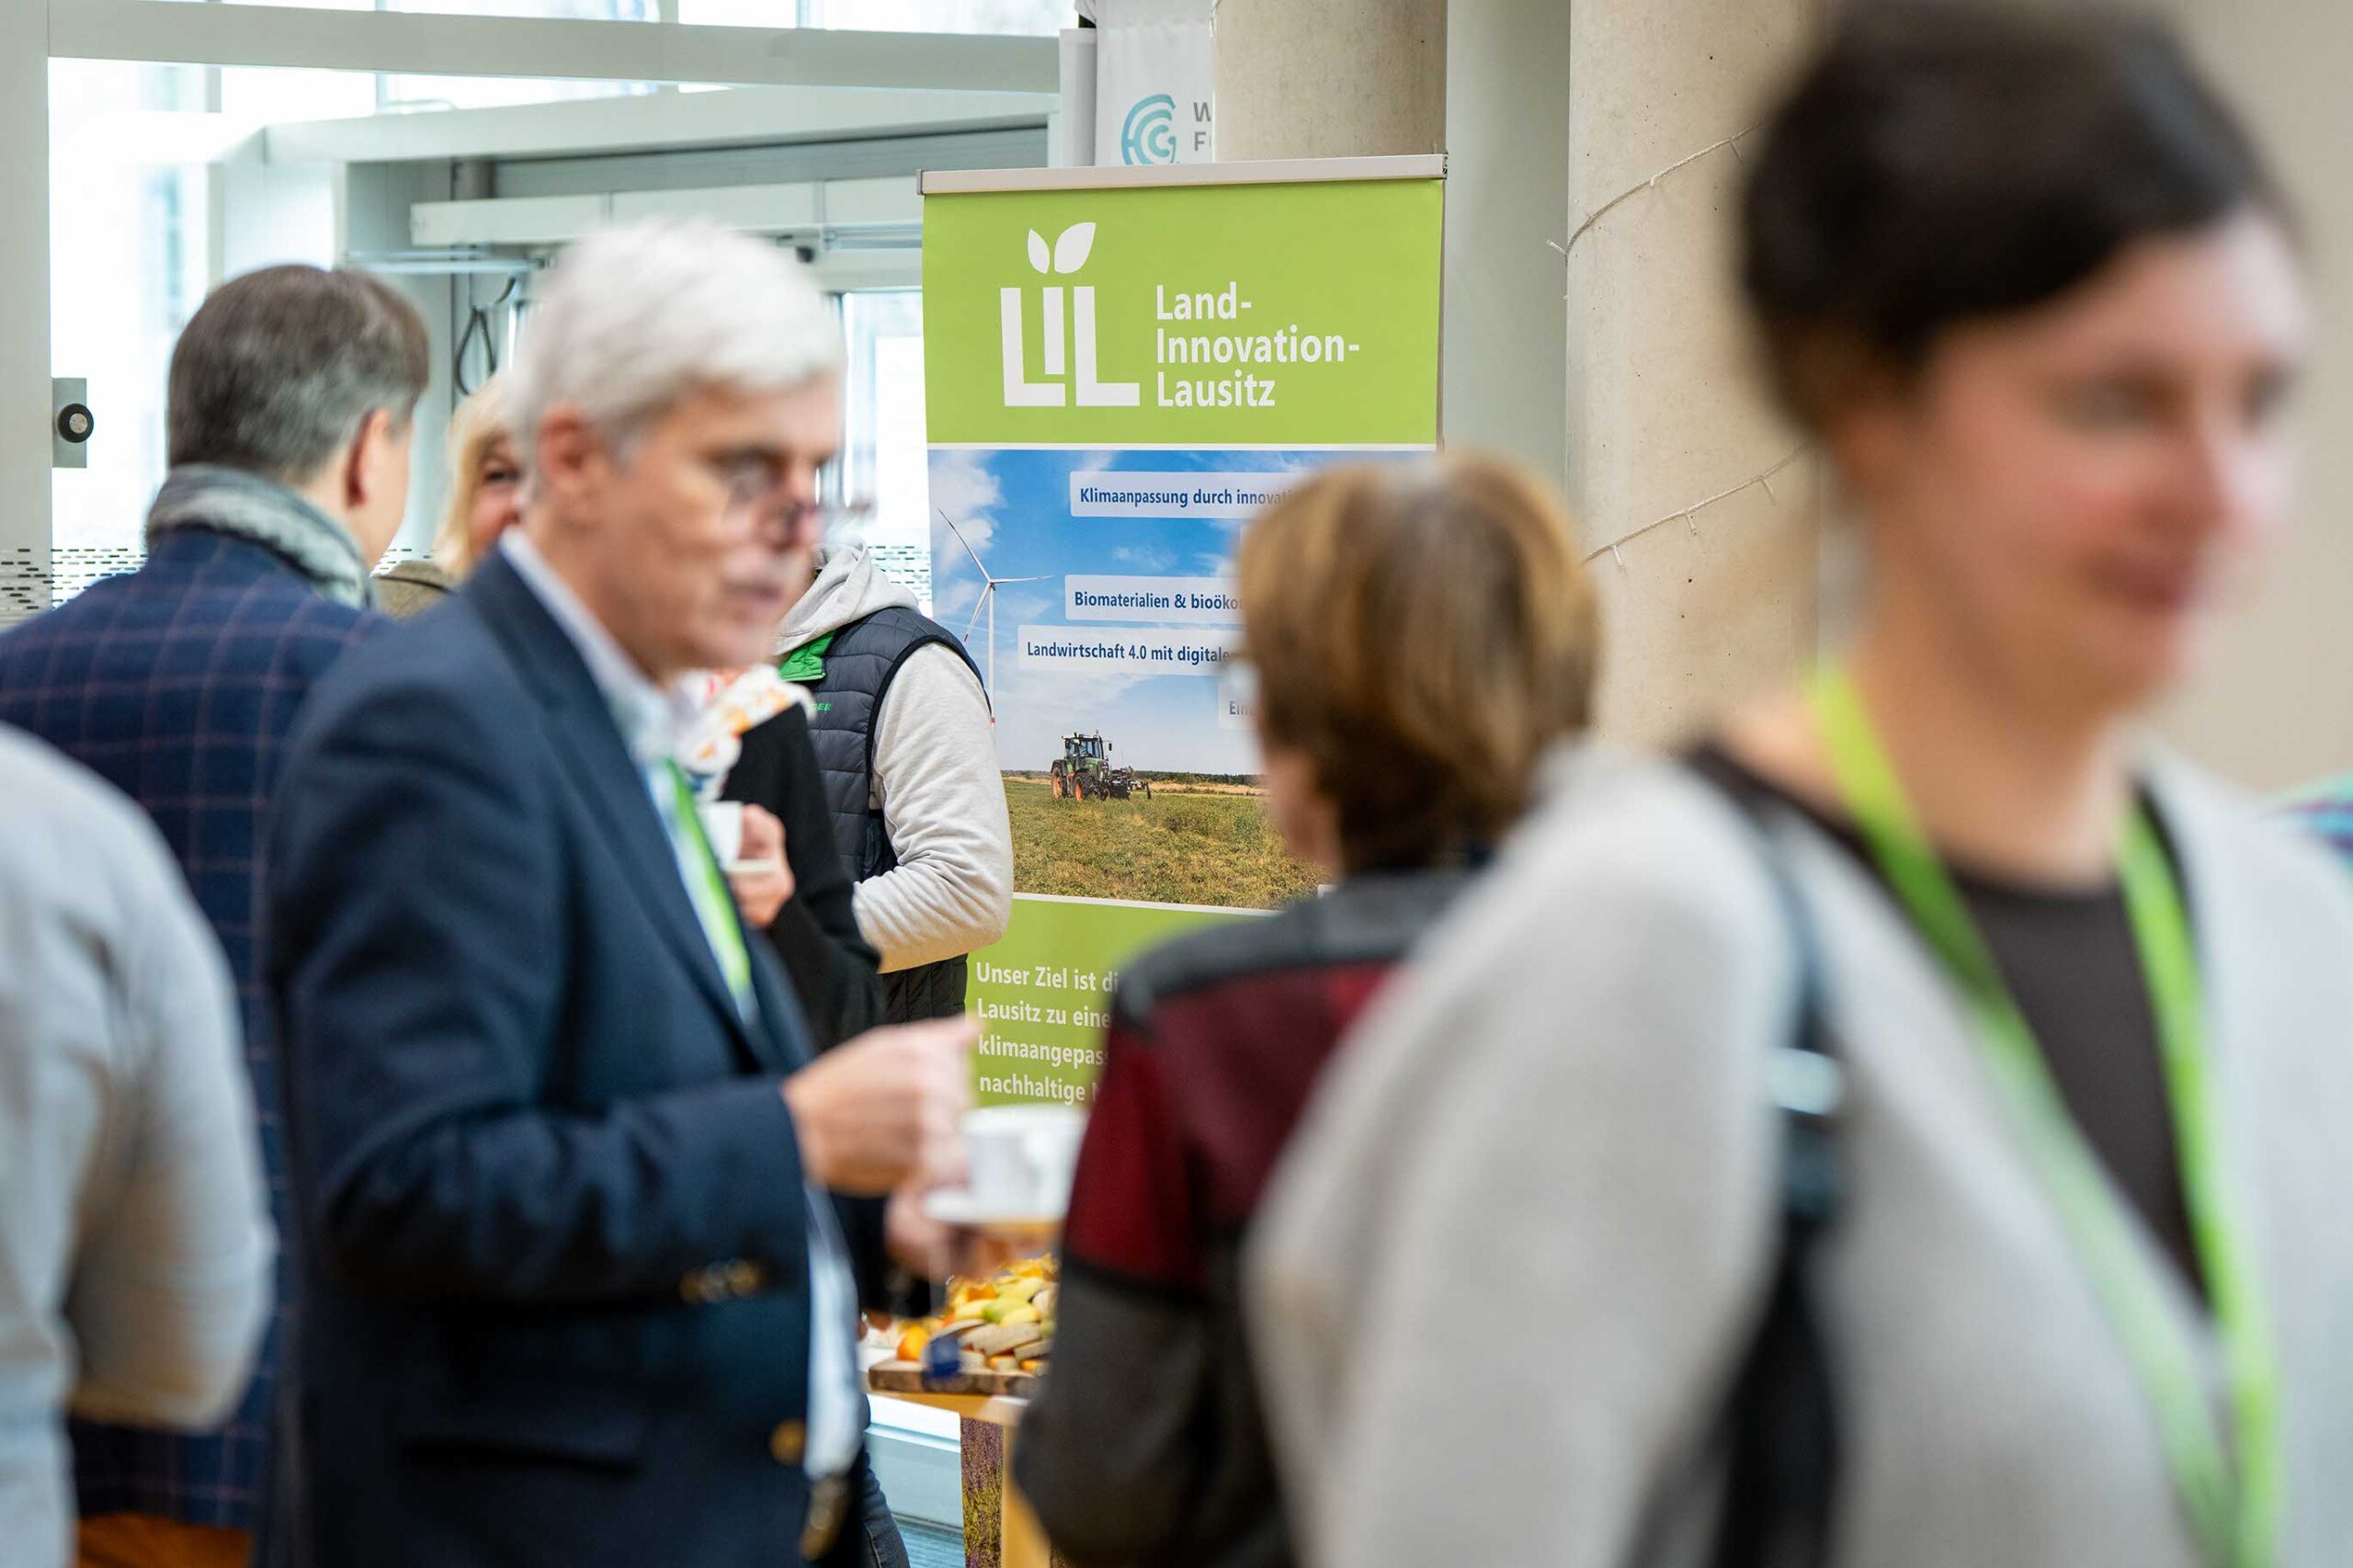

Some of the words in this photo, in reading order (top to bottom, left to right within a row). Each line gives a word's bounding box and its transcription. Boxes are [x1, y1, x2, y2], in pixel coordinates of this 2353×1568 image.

[1156, 281, 1252, 321] Land-
[1157, 324, 1359, 364] Innovation-
[1157, 369, 1276, 407] Lausitz
[1080, 487, 1188, 507] Klimaanpassung
[1193, 488, 1233, 505] durch
[1074, 591, 1169, 608] Biomaterialien
[1174, 594, 1187, 608] &
[1191, 594, 1243, 609] bioöko
[1028, 642, 1125, 659] Landwirtschaft
[1129, 645, 1147, 660] 4.0
[1151, 646, 1173, 661] mit
[1177, 646, 1238, 665] digitale
[976, 962, 1029, 985] Unser
[1035, 967, 1067, 989] Ziel
[1074, 969, 1097, 991] ist
[1102, 971, 1119, 993] di
[977, 998, 1041, 1023] Lausitz
[1046, 1009, 1066, 1025] zu
[1073, 1006, 1111, 1028] eine
[979, 1074, 1086, 1106] nachhaltige
